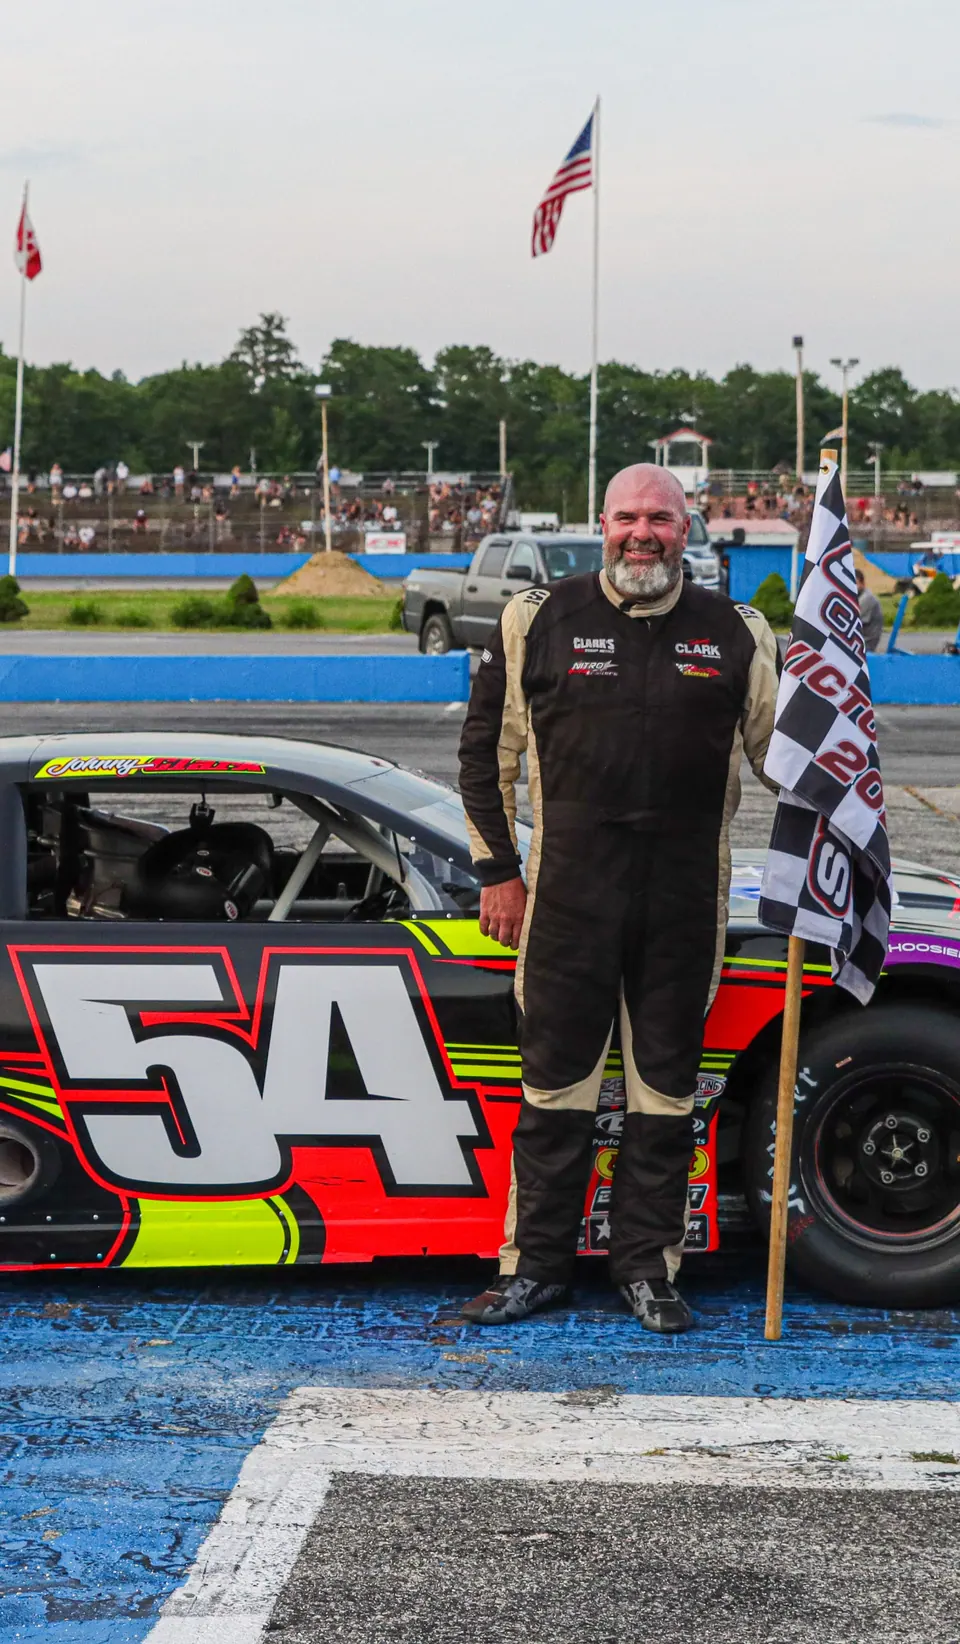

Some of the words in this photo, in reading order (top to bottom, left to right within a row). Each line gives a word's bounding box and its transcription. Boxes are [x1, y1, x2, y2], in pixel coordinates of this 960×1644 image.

[675, 643, 721, 656] CLARK
[572, 662, 604, 670] NITRO
[48, 756, 154, 777] Johnny
[32, 964, 479, 1186] 54
